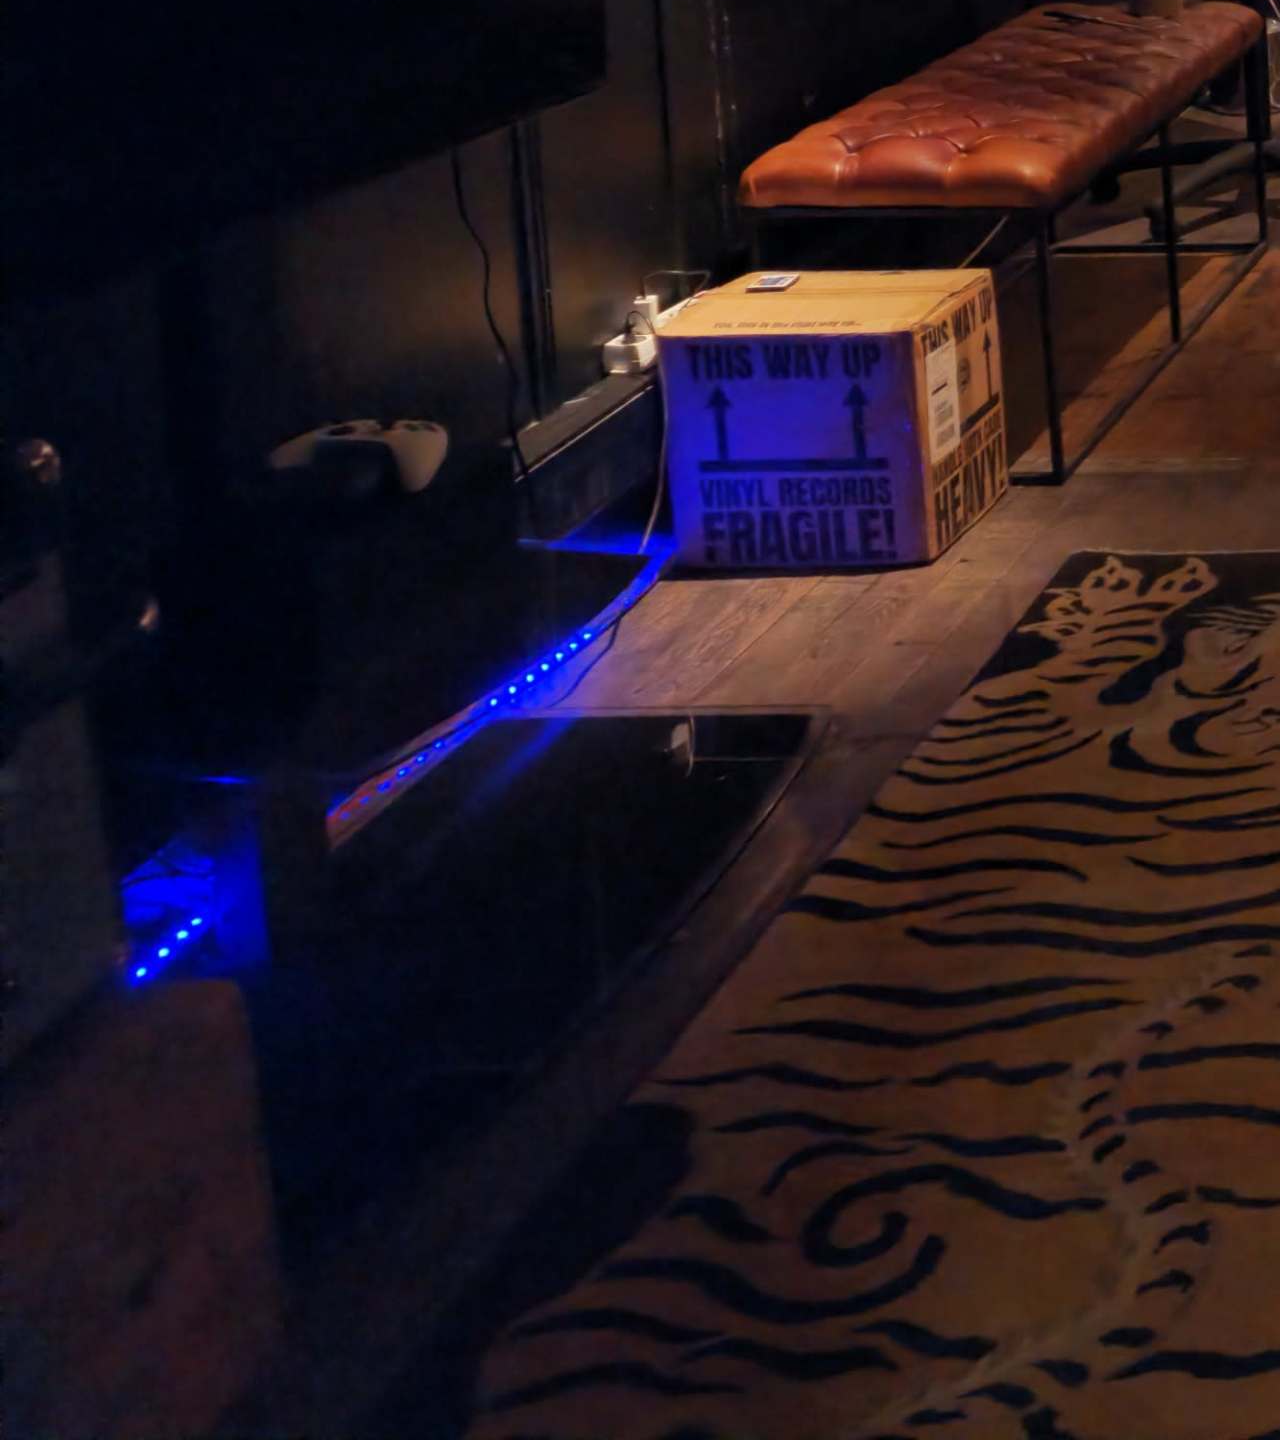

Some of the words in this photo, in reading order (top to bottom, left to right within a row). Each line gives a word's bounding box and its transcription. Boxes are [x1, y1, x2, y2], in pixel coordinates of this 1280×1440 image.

[920, 321, 950, 358] THIS
[951, 298, 976, 345] WAY
[979, 288, 993, 324] UP
[687, 344, 752, 380] THIS
[763, 343, 829, 379] WAY
[841, 343, 880, 378] UP
[700, 478, 771, 507] VINYL
[778, 477, 892, 506] RECORDS
[934, 430, 1005, 552] HEAVY!
[703, 508, 897, 562] FRAGILE!
